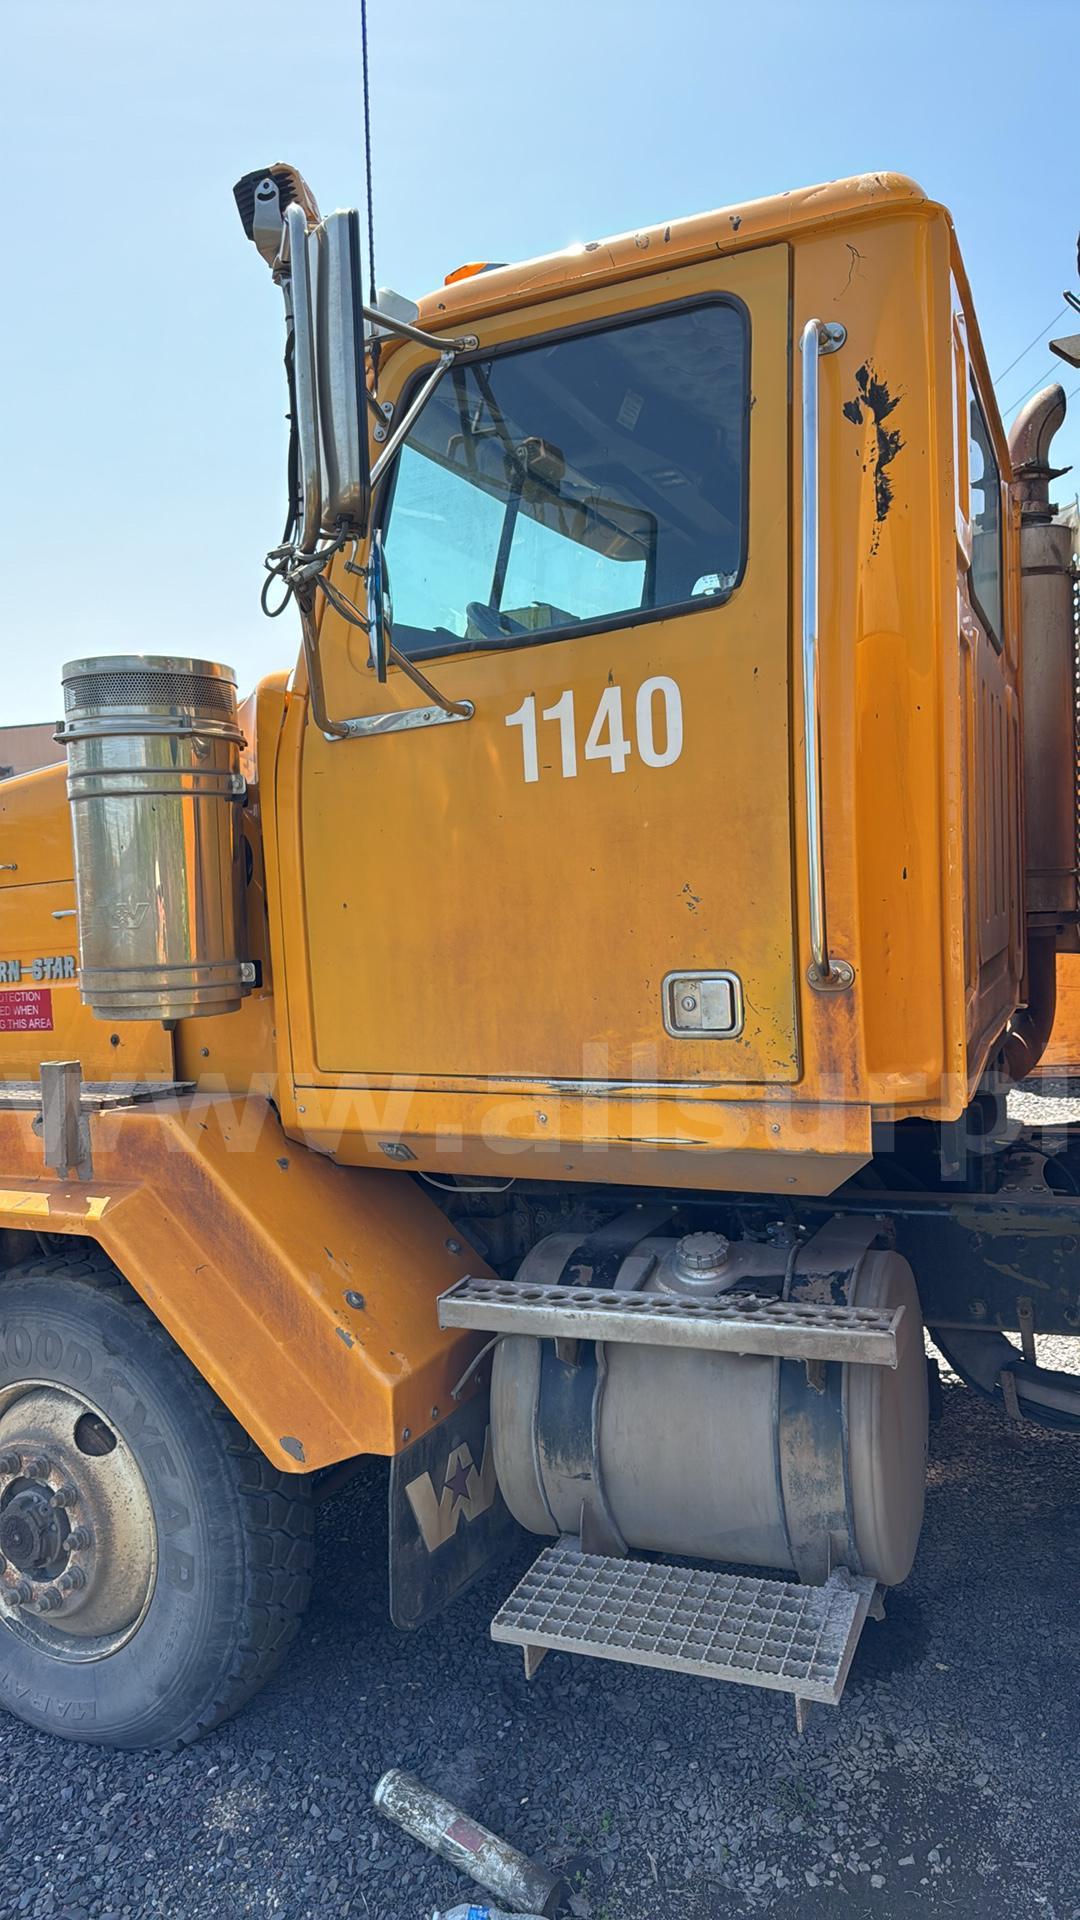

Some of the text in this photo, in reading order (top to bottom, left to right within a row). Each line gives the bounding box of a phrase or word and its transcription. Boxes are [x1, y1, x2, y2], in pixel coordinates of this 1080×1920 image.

[505, 675, 683, 783] 1140
[14, 1004, 39, 1016] WHEN
[7, 1018, 27, 1029] THIS
[28, 1018, 52, 1029] AREA
